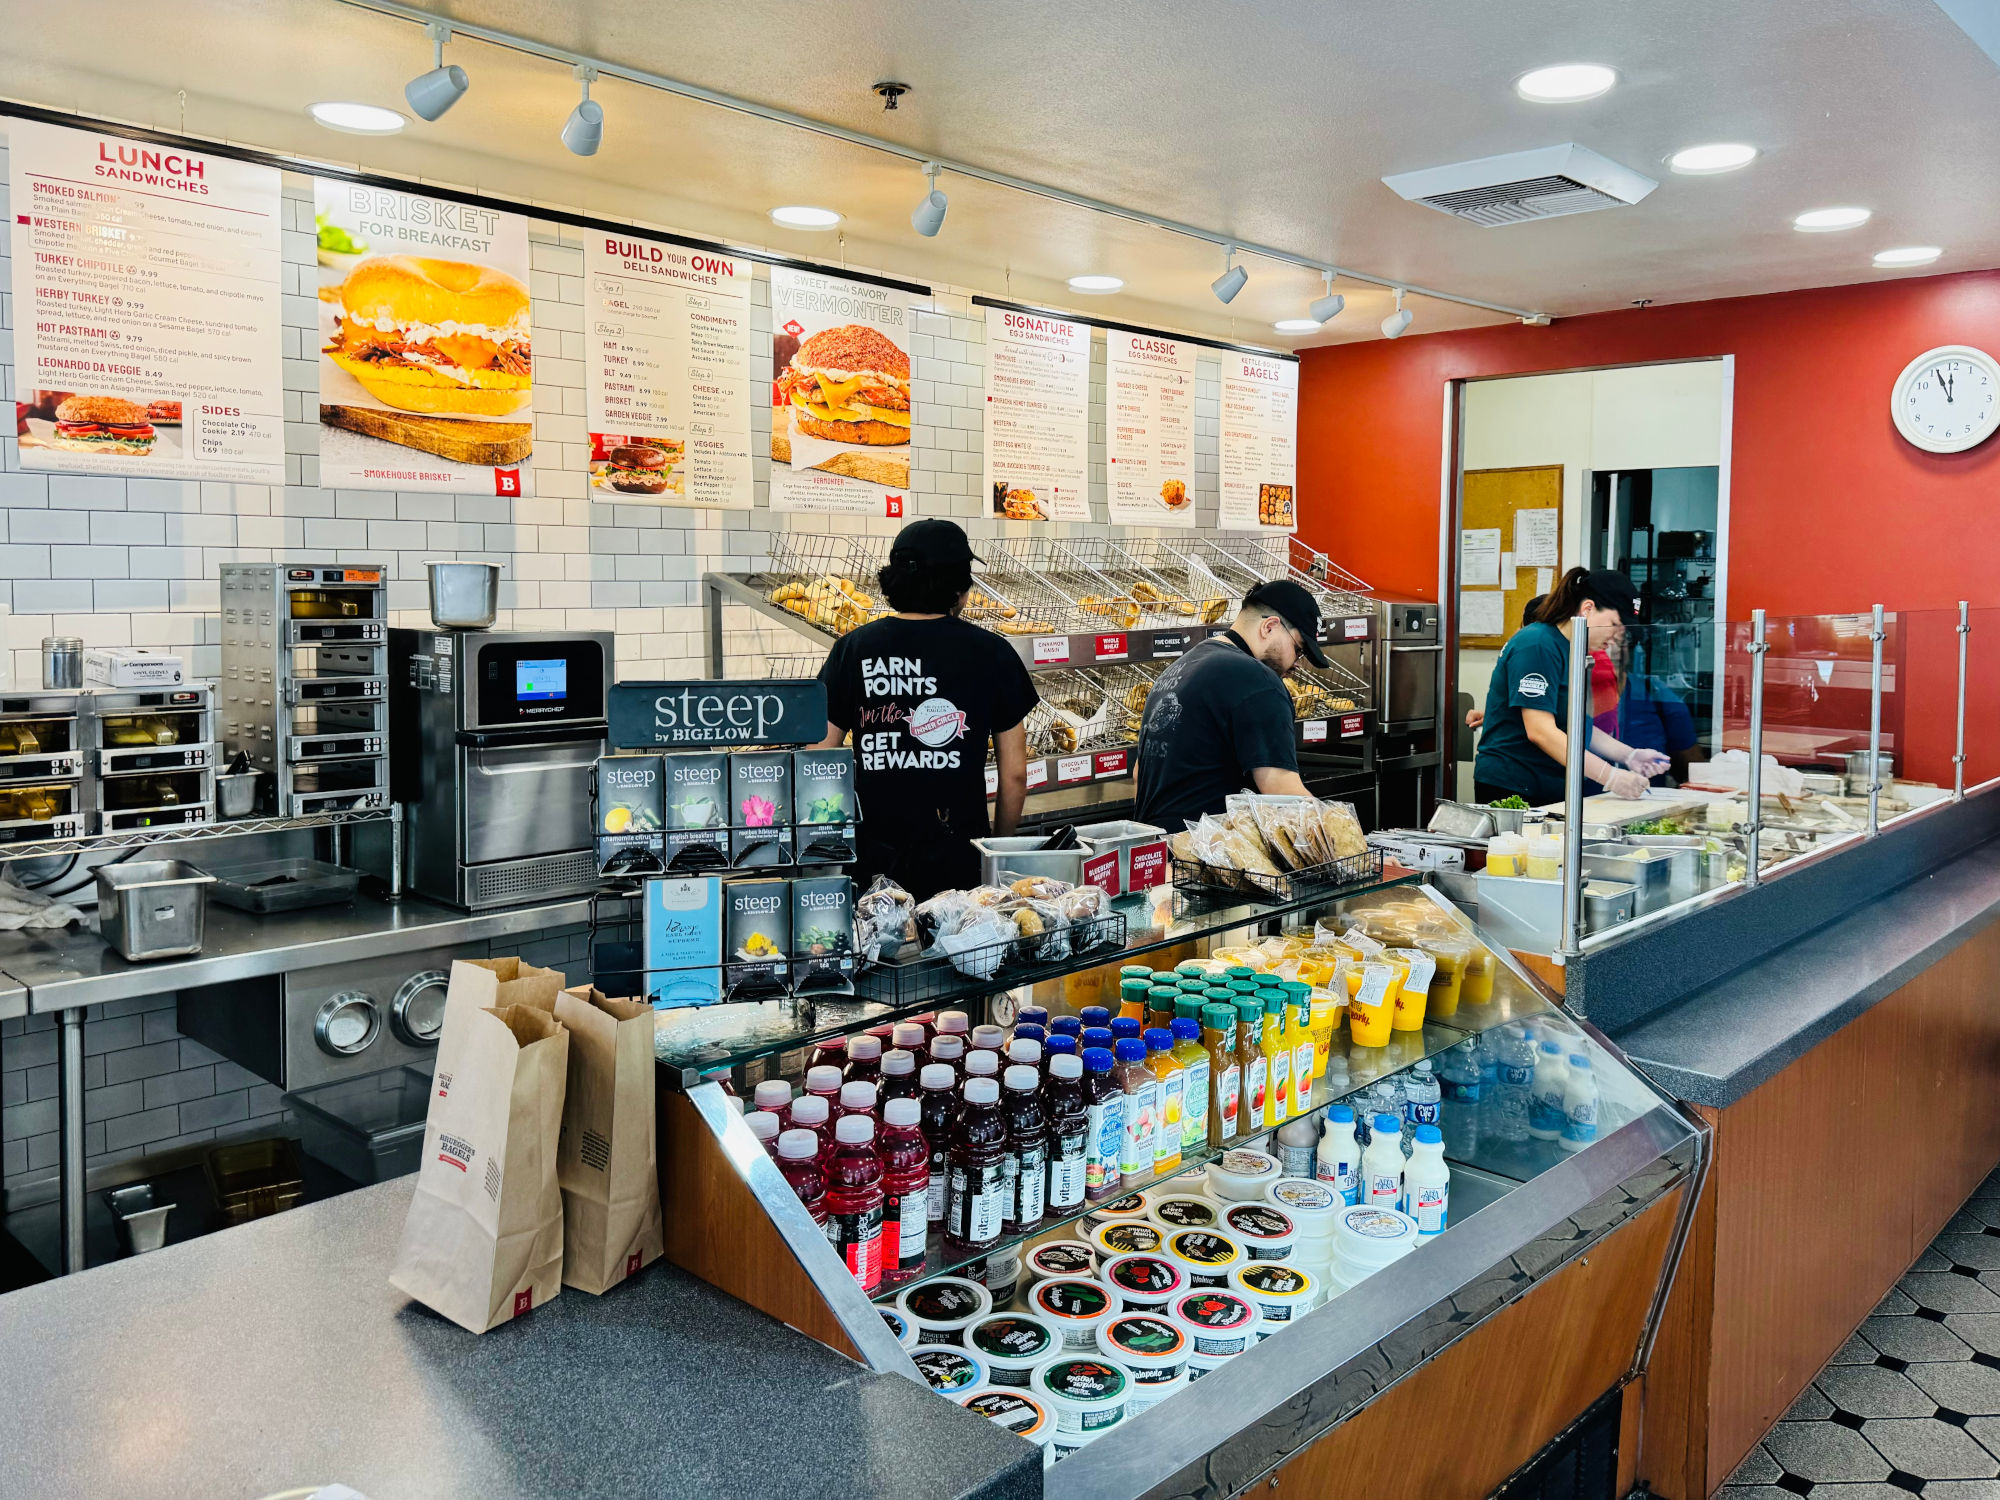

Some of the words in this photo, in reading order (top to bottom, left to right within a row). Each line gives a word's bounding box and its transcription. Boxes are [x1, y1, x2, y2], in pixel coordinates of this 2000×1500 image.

[99, 142, 204, 180] LUNCH
[95, 165, 209, 195] SANDWICHES
[33, 182, 75, 198] SMOKED
[348, 186, 501, 237] BRISKET
[34, 217, 82, 233] WESTERN
[86, 224, 128, 240] BRISKET
[359, 220, 394, 239] FOR
[398, 227, 491, 253] BREAKFAST
[605, 239, 663, 263] BUILD
[666, 251, 687, 266] YOUR
[691, 255, 734, 277] OWN
[35, 252, 74, 267] TURKEY
[76, 257, 124, 273] CHIPOTLE
[140, 269, 158, 278] 9.99
[623, 261, 649, 273] DELI
[651, 265, 717, 286] SANDWICHES
[35, 264, 67, 275] Roasted
[68, 267, 93, 280] turkey,
[94, 272, 128, 284] peppered
[129, 276, 153, 287] bacon,
[153, 280, 179, 290] lettuce,
[180, 284, 206, 294] tomato,
[206, 288, 219, 296] and
[219, 290, 245, 300] chipotle
[793, 275, 829, 290] SWEET
[829, 284, 850, 293] meets
[851, 286, 888, 301] SAVORY
[36, 287, 70, 301] HERBY
[72, 291, 110, 305] TURKEY
[126, 302, 145, 310] 9.99
[777, 285, 903, 326] VERMONTER
[690, 312, 737, 327] CONDIMENTS
[1004, 313, 1074, 337] SIGNATURE
[36, 322, 57, 333] HOT
[59, 324, 107, 340] PASTRAMI
[125, 335, 144, 343] 9.79
[787, 324, 801, 334] NEW
[1009, 329, 1024, 339] EGG
[1025, 331, 1070, 346] SANDWICHES
[603, 341, 617, 350] HAM
[1131, 338, 1176, 356] CLASSIC
[603, 354, 629, 365] TURKEY
[1128, 350, 1142, 359] EGG
[1142, 352, 1178, 365] SANDWICHES
[37, 356, 91, 371] LEONARDO
[93, 362, 106, 373] DA
[107, 363, 142, 377] VEGGIE
[145, 370, 164, 378] 8.49
[604, 369, 616, 377] BLT
[1243, 365, 1279, 381] BAGELS
[1948, 362, 1959, 371] 12
[1968, 365, 1973, 374] 1
[604, 382, 635, 393] PASTRAMI
[1917, 381, 1929, 390] 10
[1981, 377, 1987, 385] 2
[692, 384, 721, 395] CHEESE
[605, 395, 632, 406] BRISKET
[1910, 397, 1916, 406] 9
[1986, 394, 1993, 403] 3
[201, 405, 242, 417] SIDES
[605, 409, 630, 420] GARDEN
[630, 411, 653, 422] VEGGIE
[1978, 411, 1984, 420] 4
[202, 419, 239, 429] Chocolate
[240, 422, 258, 430] Chip
[1914, 414, 1921, 422] 8
[202, 427, 228, 436] Cookie
[231, 429, 247, 437] 2.19
[1928, 425, 1934, 433] 7
[1945, 430, 1952, 438] 6
[1964, 424, 1971, 433] 5
[202, 438, 224, 447] Chips
[693, 440, 725, 449] VEGGIES
[202, 446, 218, 454] 1.69
[364, 469, 417, 481] SMOKEHOUSE
[419, 472, 452, 482] BRISKET
[812, 477, 845, 486] VERMONTER
[501, 477, 515, 491] B
[890, 502, 900, 514] B
[861, 656, 921, 678] EARN
[863, 676, 938, 698] POINTS
[526, 706, 565, 714] MERRYCHEF
[655, 687, 784, 739] steep
[878, 702, 905, 724] the
[914, 721, 938, 735] INNER
[937, 713, 961, 726] CIRCLE
[655, 732, 669, 743] by
[672, 727, 753, 741] BIGELOW
[861, 732, 902, 752] GET
[861, 750, 961, 770] REWARDS
[1061, 759, 1089, 768] CHOCOLATE
[1098, 753, 1124, 763] CINNAMON
[1103, 760, 1119, 768] SUGAR
[674, 766, 721, 785] steep
[739, 763, 785, 783] steep
[803, 761, 848, 780] steep
[1027, 767, 1043, 776] BERRY
[607, 768, 656, 787] steep
[635, 832, 652, 841] citrus
[669, 832, 689, 842] english
[689, 831, 714, 840] breakfast
[1134, 850, 1163, 862] CHOCOLATE
[1088, 860, 1116, 877] BLUEBERRY
[1133, 861, 1146, 870] CHIP
[1145, 858, 1163, 867] COOKIE
[1093, 869, 1111, 882] MUFFIN
[735, 894, 782, 914] steep
[800, 891, 846, 909] steep
[439, 1133, 476, 1157] BRUEGGER'S
[441, 1142, 471, 1163] BAGELS
[855, 1213, 869, 1288] vitaminwater
[1066, 1374, 1096, 1385] Veggie
[1071, 1381, 1105, 1392] Garden
